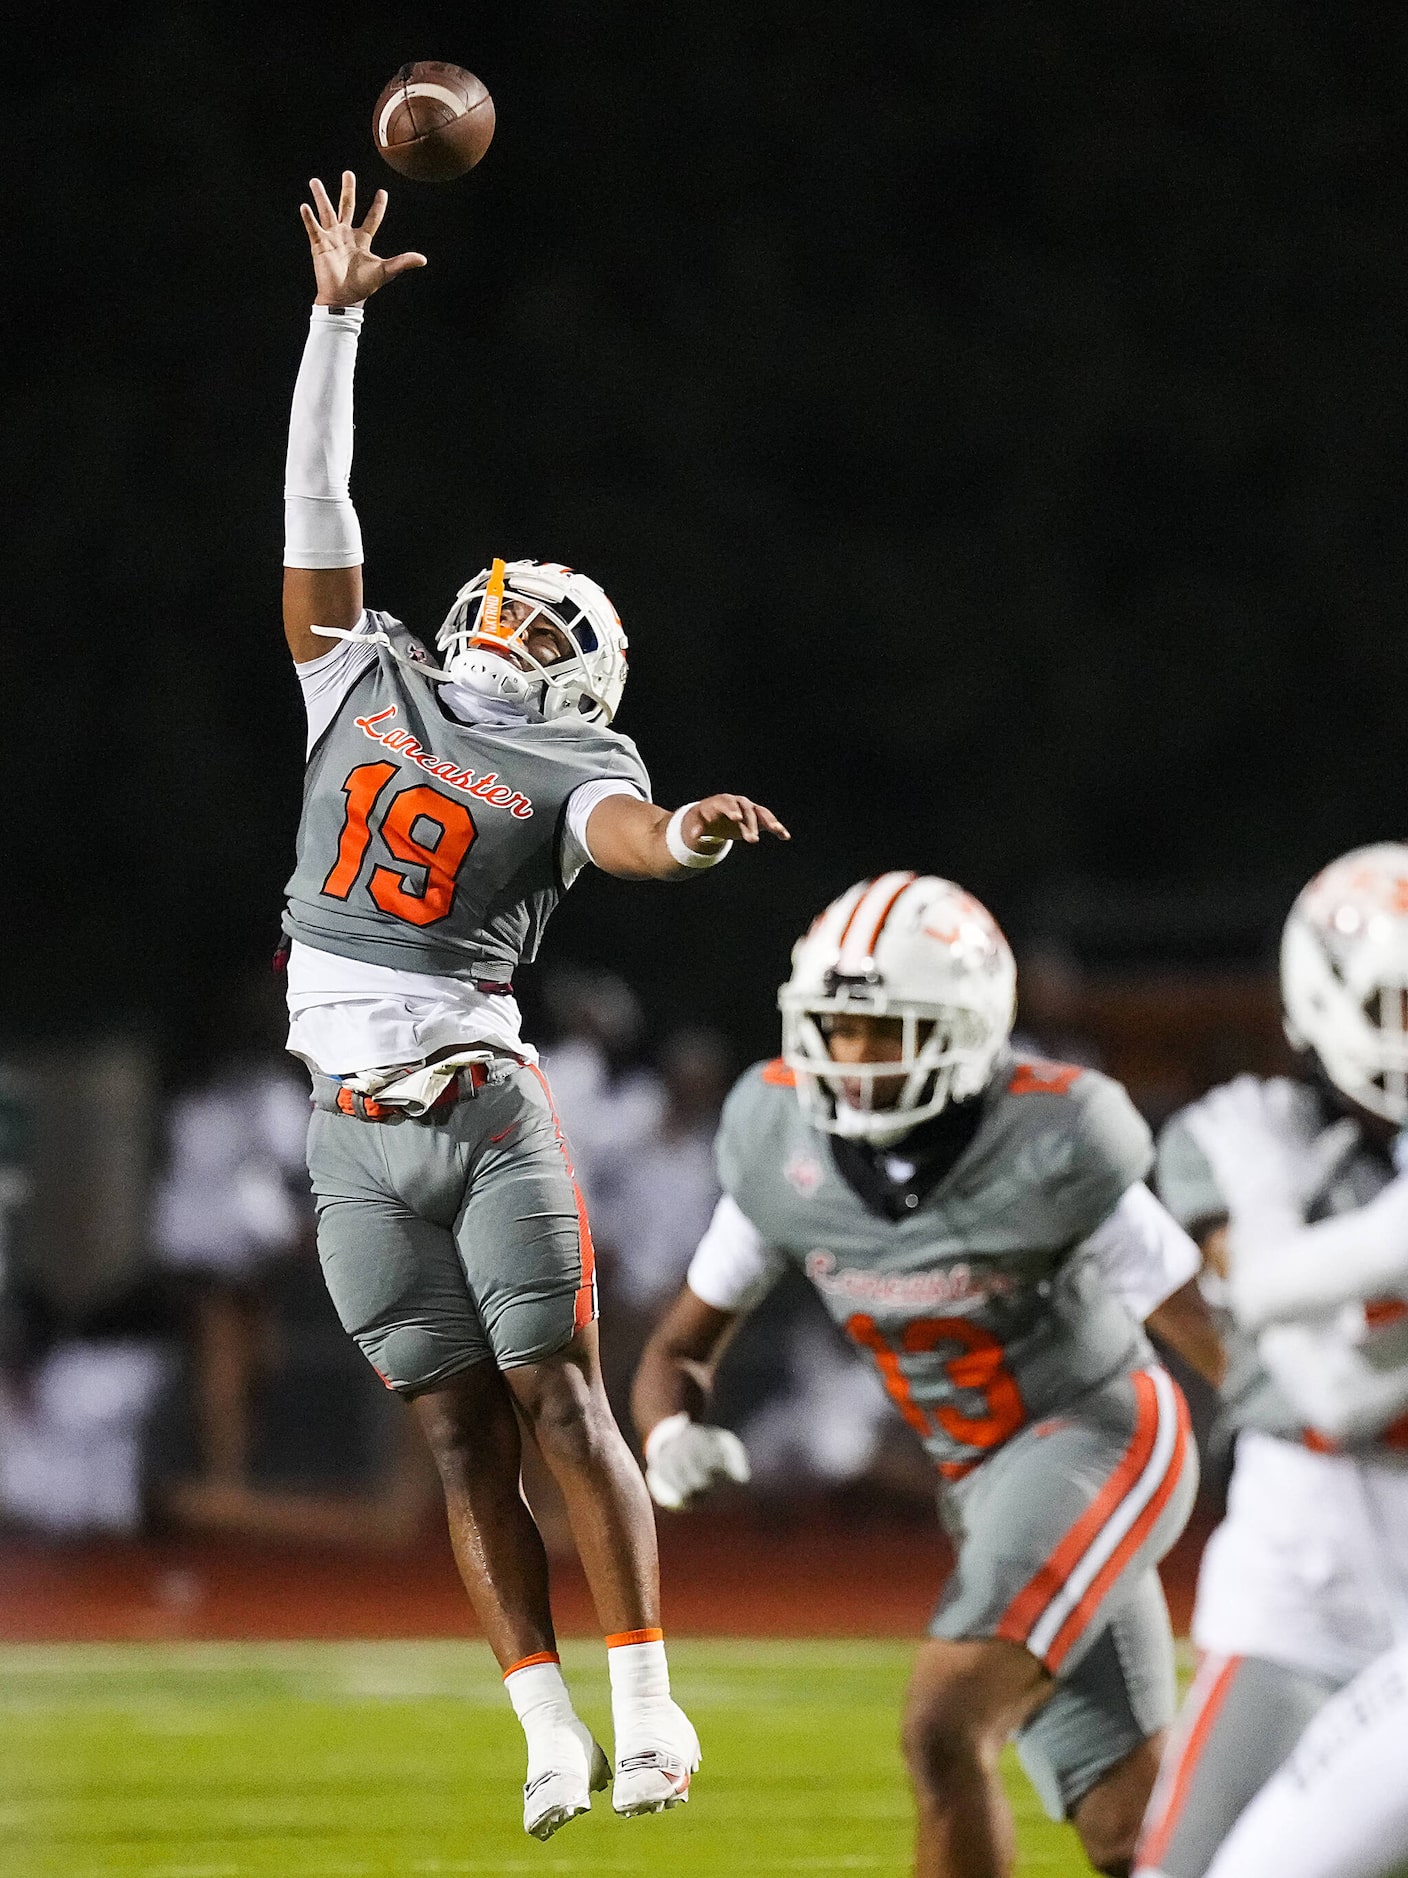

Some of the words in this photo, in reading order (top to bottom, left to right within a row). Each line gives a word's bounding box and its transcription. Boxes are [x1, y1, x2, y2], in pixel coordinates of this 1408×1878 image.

[354, 703, 534, 820] Lancaster
[319, 759, 479, 929] 19
[844, 1312, 1026, 1449] 13
